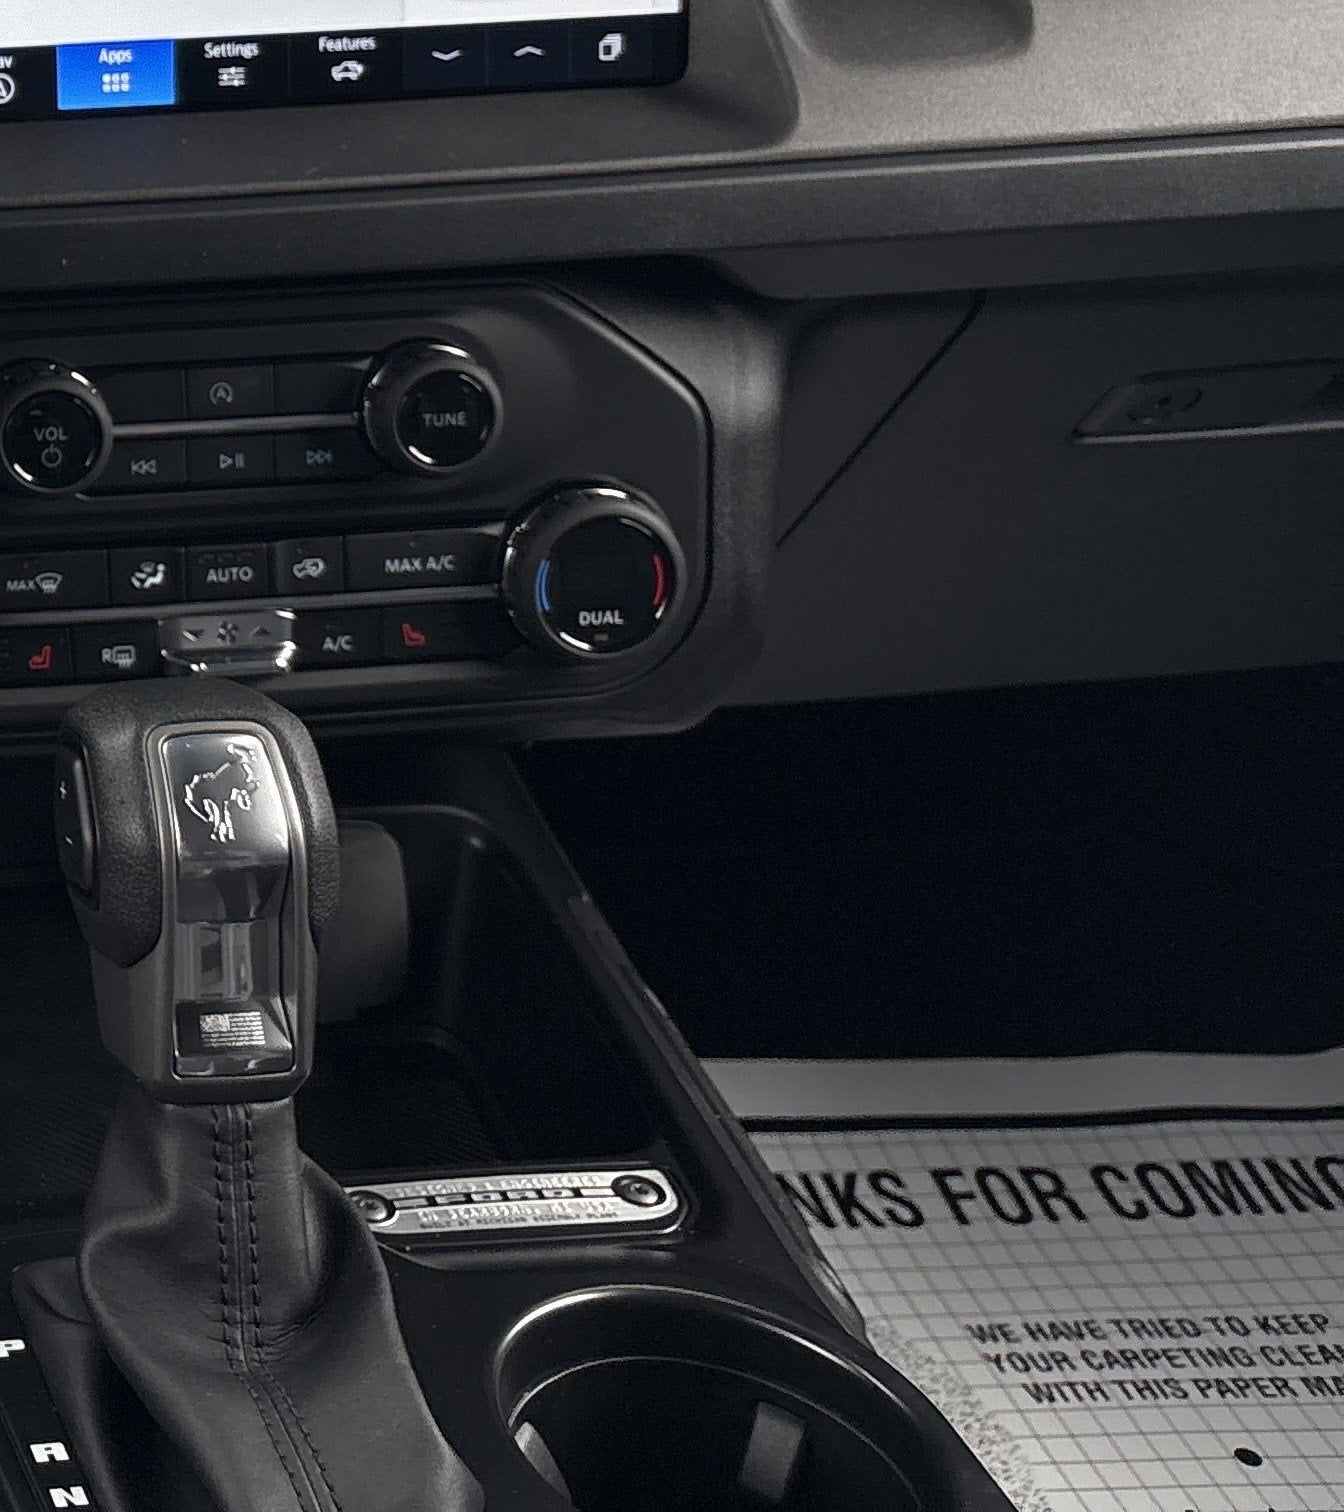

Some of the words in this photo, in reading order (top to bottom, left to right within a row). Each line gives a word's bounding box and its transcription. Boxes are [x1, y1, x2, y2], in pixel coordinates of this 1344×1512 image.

[204, 42, 259, 60] Settings
[318, 36, 377, 53] Features
[98, 47, 133, 66] Apps
[422, 410, 467, 429] TUNE
[33, 425, 68, 443] VOL
[384, 556, 423, 574] MAX
[425, 554, 456, 571] A/C
[206, 566, 254, 584] AUTO
[6, 579, 35, 593] MAX
[578, 609, 625, 626] DUAL
[322, 635, 354, 652] A/C
[774, 1169, 926, 1229] NKS
[929, 1164, 1087, 1226] FOR
[963, 1322, 1022, 1344] WE
[1021, 1318, 1108, 1342] HAVE
[1106, 1316, 1202, 1339] TRIED
[1203, 1315, 1251, 1337] TO
[1252, 1313, 1329, 1336] KEEP
[981, 1350, 1077, 1374] YOUR
[1079, 1345, 1257, 1371] CARPETING
[1020, 1381, 1110, 1404] WITH
[1111, 1377, 1189, 1400] THIS
[1189, 1376, 1299, 1400] PAPER
[48, 1485, 90, 1508] N
